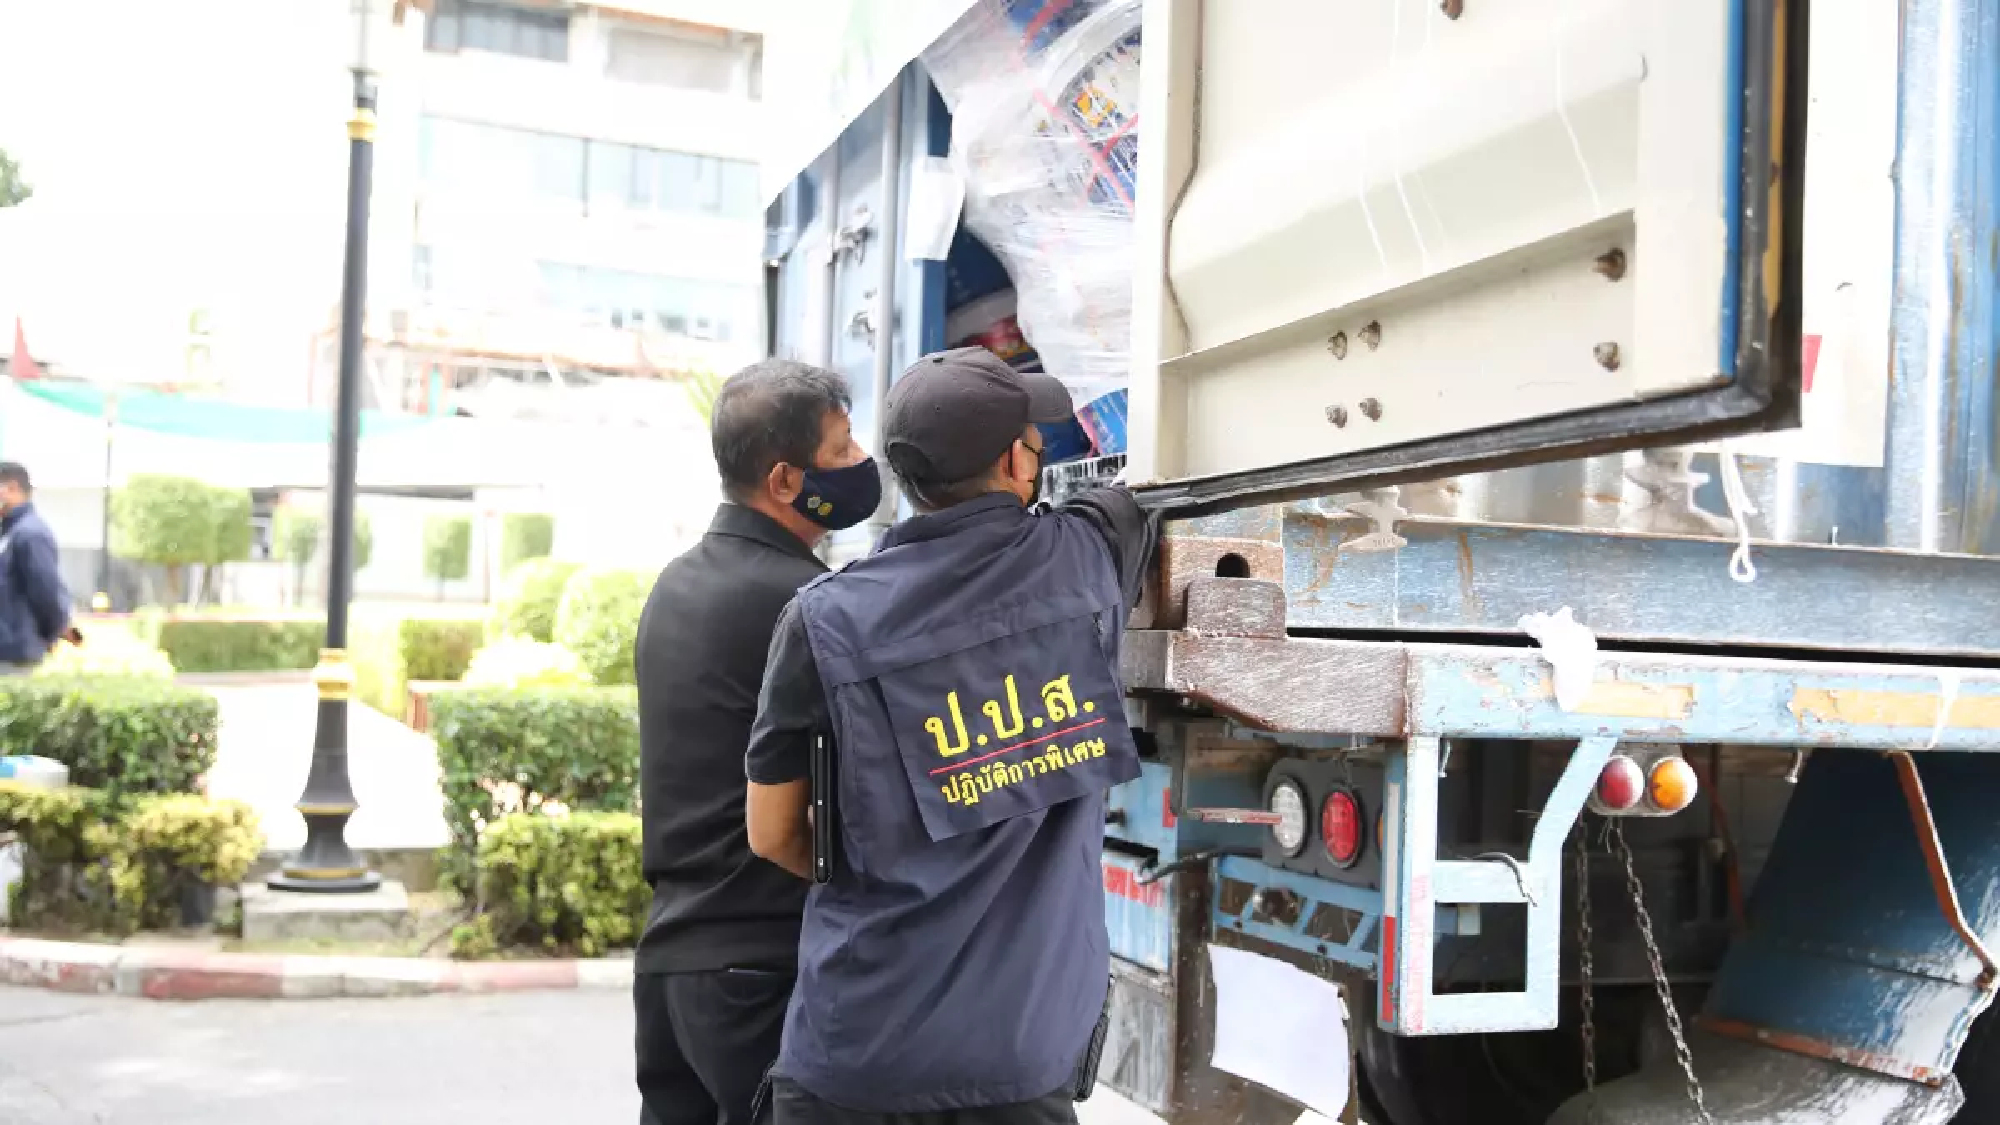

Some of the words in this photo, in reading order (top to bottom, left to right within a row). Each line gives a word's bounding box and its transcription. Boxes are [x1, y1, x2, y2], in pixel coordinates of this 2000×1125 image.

[923, 674, 1096, 758] ป.ป.ส.
[941, 737, 1106, 806] ปฏิบัติการพิเศษ
